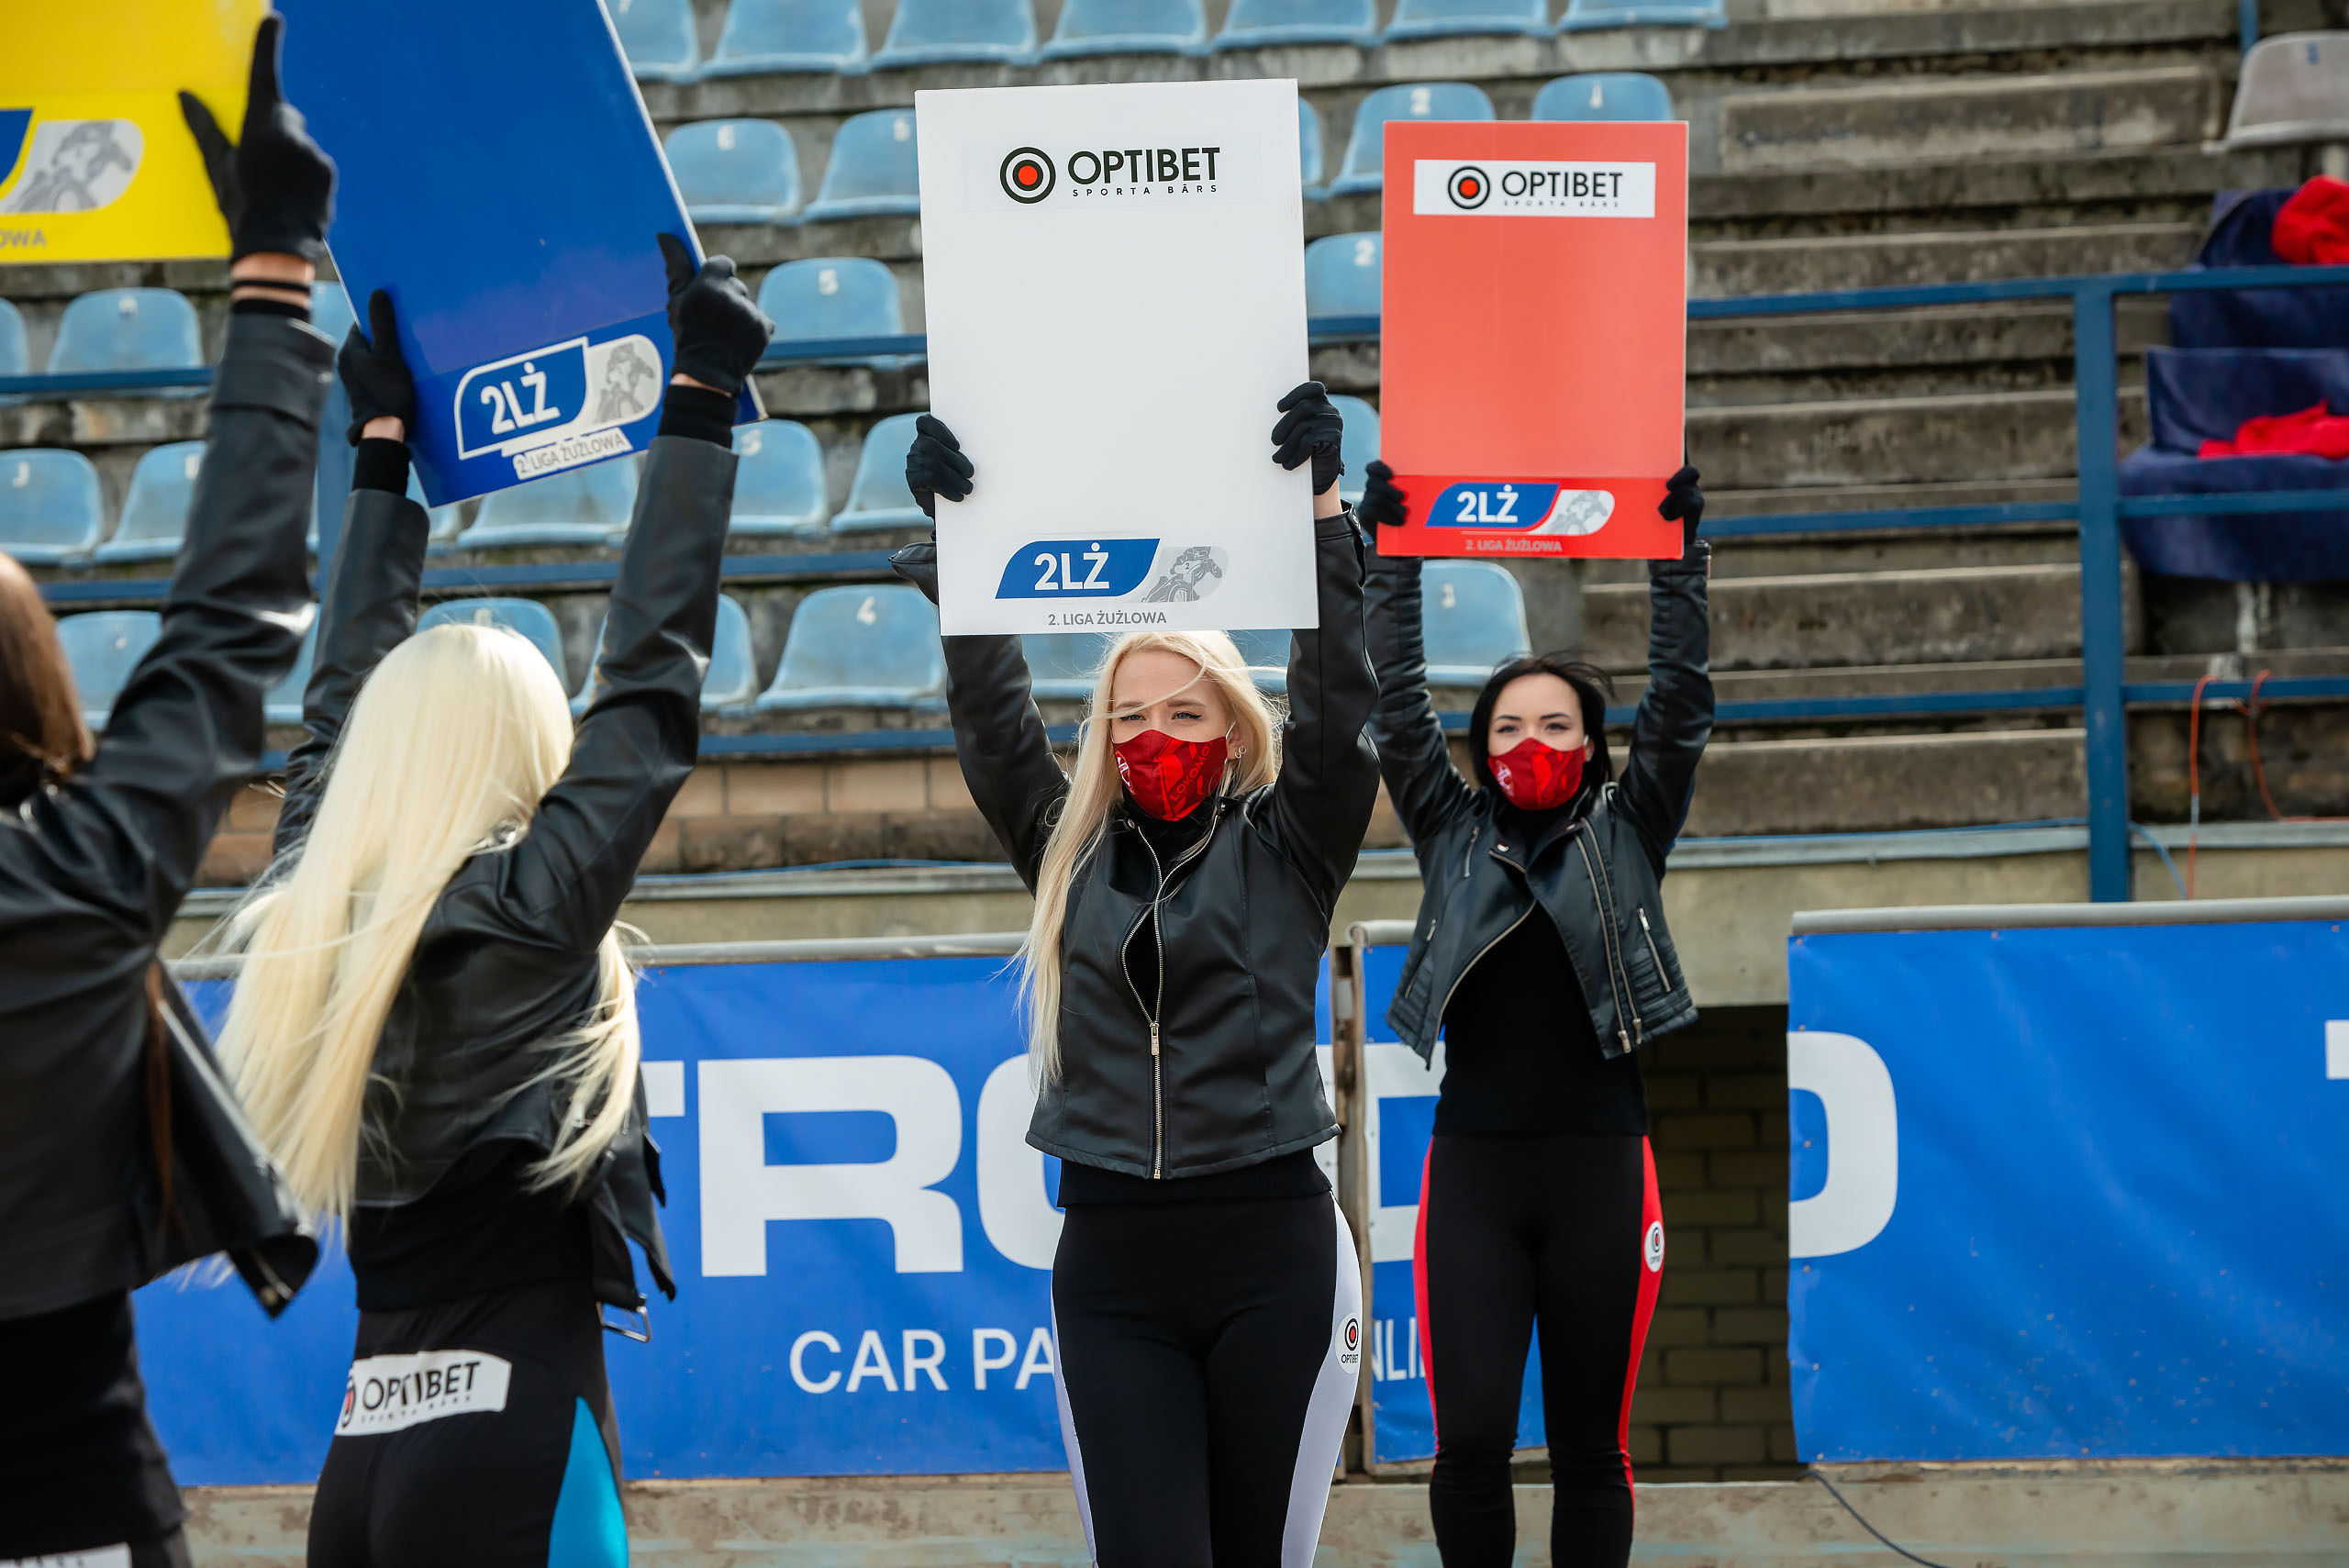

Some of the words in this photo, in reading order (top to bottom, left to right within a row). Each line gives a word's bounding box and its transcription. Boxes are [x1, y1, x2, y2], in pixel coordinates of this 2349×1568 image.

[1068, 147, 1220, 184] OPTIBET
[1502, 171, 1622, 197] OPTIBET
[1073, 186, 1151, 197] SPORTA
[1167, 183, 1217, 194] BĀRS
[480, 361, 561, 435] 2LŻ
[530, 452, 559, 471] LIGA
[1456, 484, 1519, 523] 2LŻ
[1477, 539, 1504, 550] LIGA
[1034, 542, 1109, 591] 2LŻ
[1048, 614, 1060, 626] 2.
[1063, 613, 1094, 626] LIGA
[1097, 610, 1167, 625] ŻUŻLOWA
[1170, 741, 1212, 801] LOKOMO
[789, 1329, 950, 1394] CAR
[973, 1327, 1054, 1391] PA
